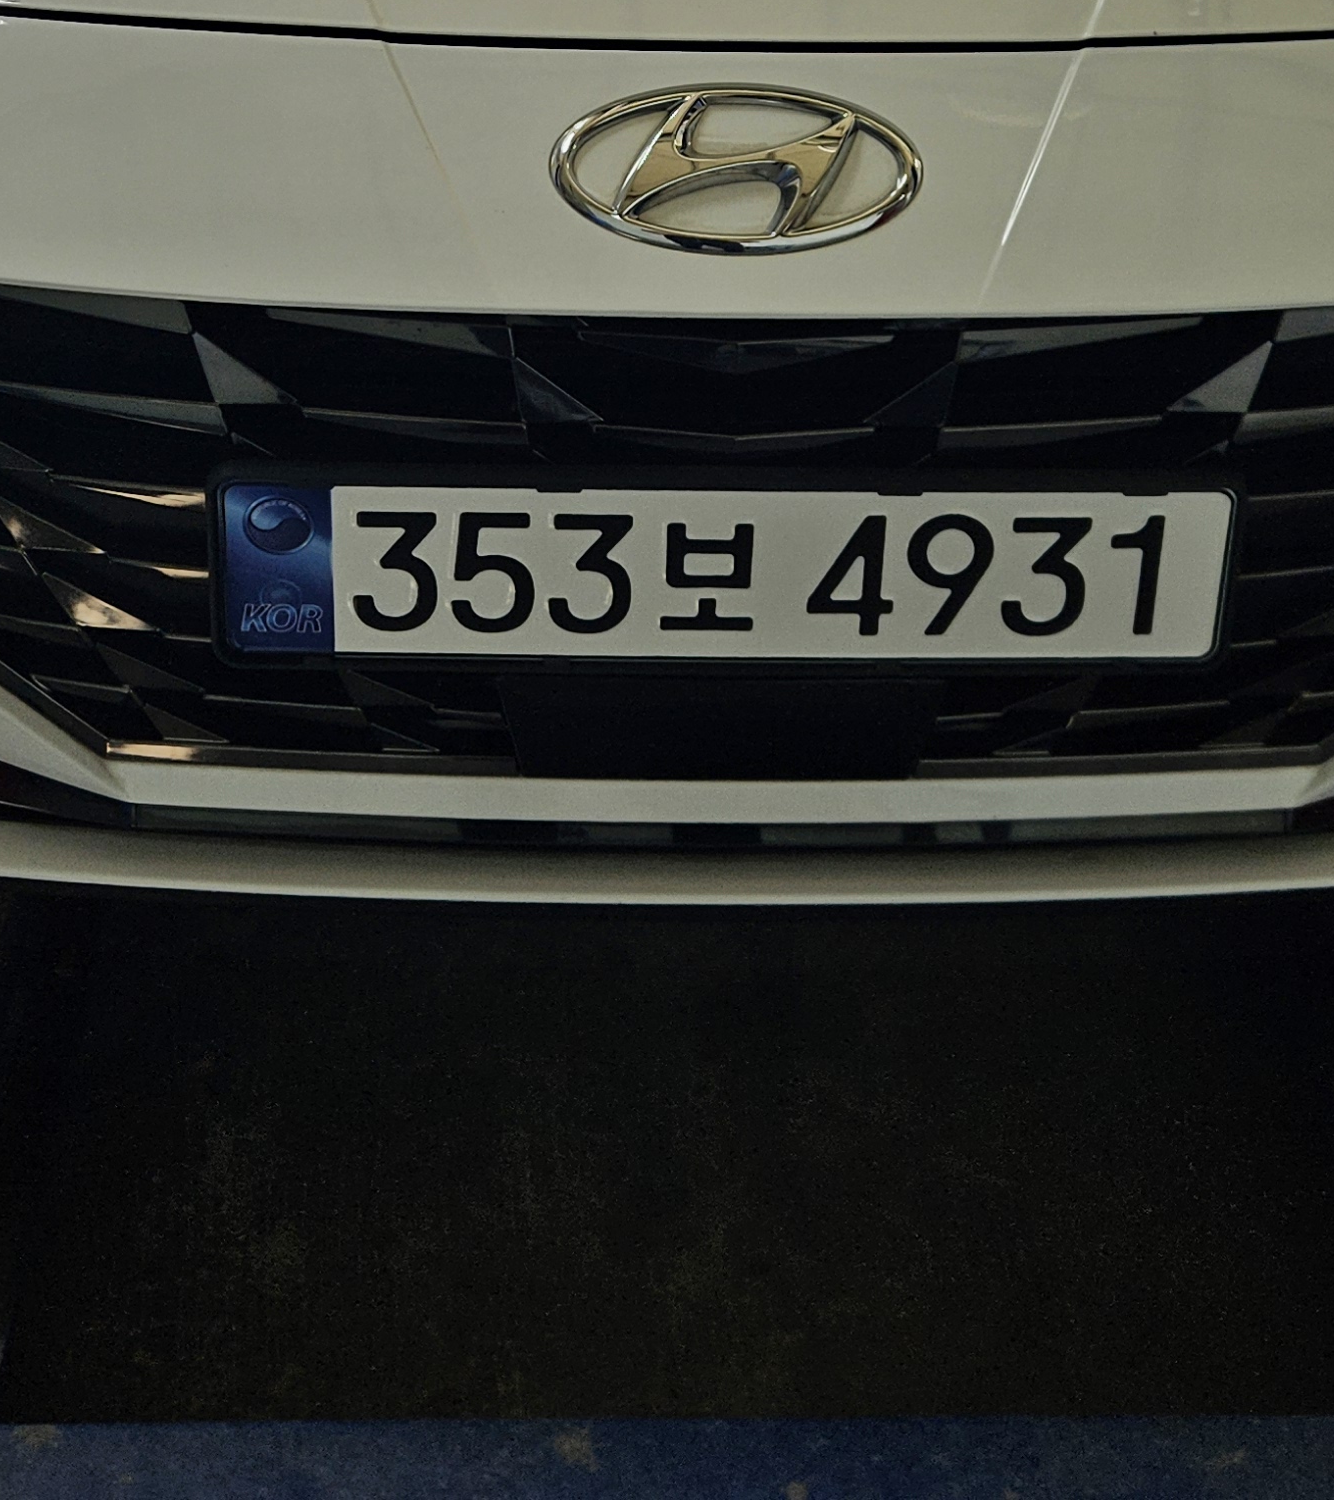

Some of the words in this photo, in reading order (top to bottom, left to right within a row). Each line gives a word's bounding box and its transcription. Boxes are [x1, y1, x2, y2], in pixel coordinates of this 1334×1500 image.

[352, 510, 755, 635] 353보
[805, 513, 1165, 637] 4931
[240, 602, 324, 633] KOR
